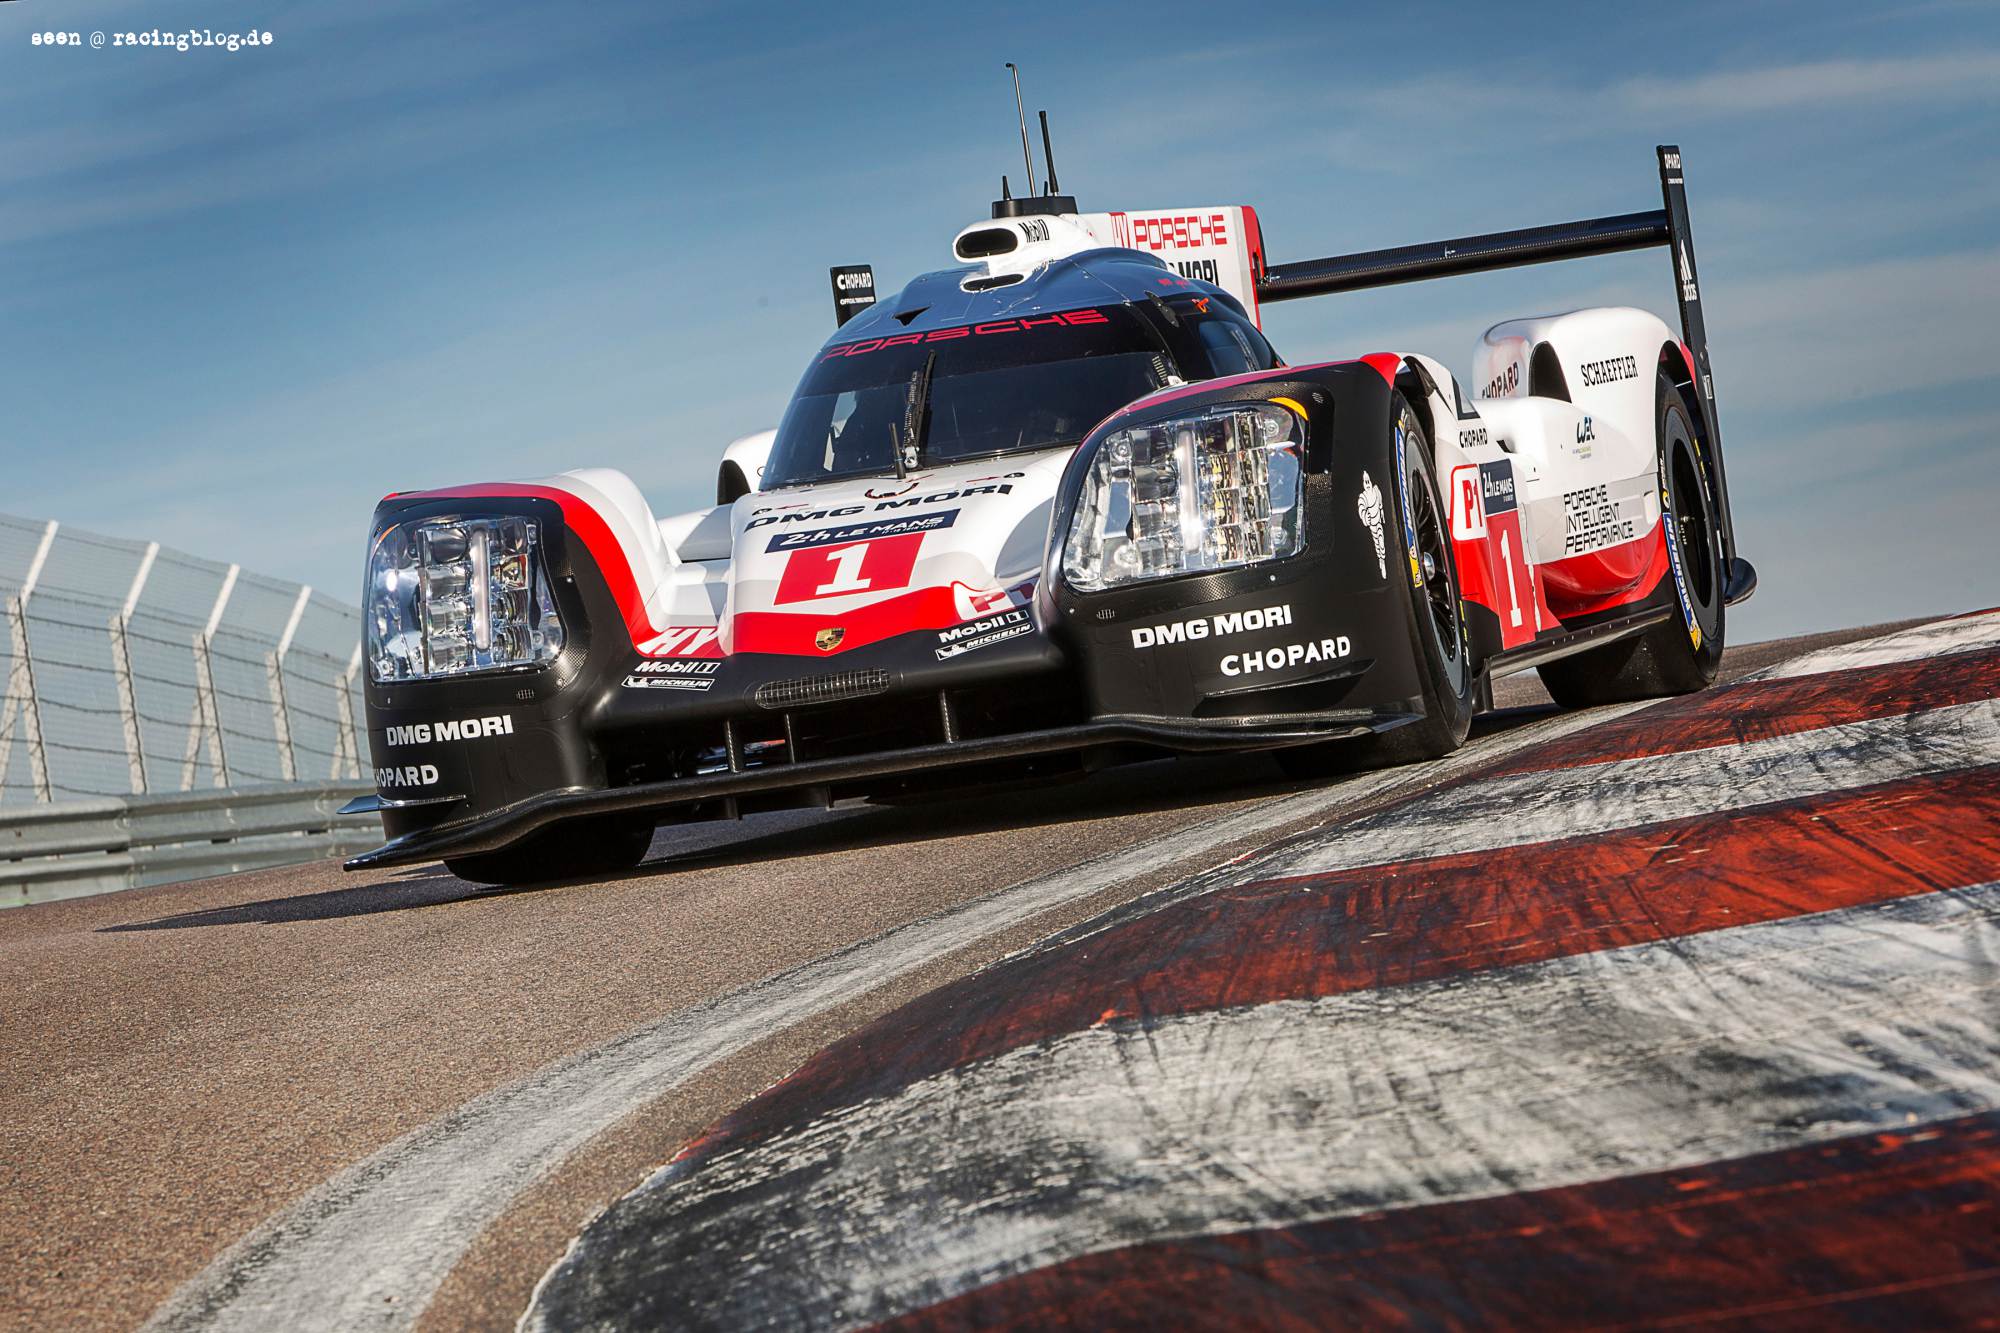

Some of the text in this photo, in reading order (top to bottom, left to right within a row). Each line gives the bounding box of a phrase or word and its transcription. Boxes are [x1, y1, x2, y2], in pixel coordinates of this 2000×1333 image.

[1133, 214, 1227, 250] PORSCHE
[837, 272, 872, 290] CHOPARD
[819, 310, 1109, 363] PORSCHE
[1580, 355, 1638, 387] SCHAEFFLER
[1459, 428, 1488, 449] CHOPARD
[1500, 477, 1513, 495] MANS
[1564, 484, 1608, 512] PORSCHE
[744, 484, 1014, 533] DMG MORI
[1462, 477, 1483, 529] P1
[1566, 503, 1619, 534] INTELLIGENT
[834, 528, 869, 539] LE
[869, 516, 945, 534] MANS
[1565, 521, 1634, 555] PERFORMANCE
[815, 543, 871, 596] 1
[1500, 529, 1523, 628] 1
[636, 628, 718, 655] HY
[938, 616, 1006, 643] Mobil
[966, 624, 1031, 648] MICHELIN
[1131, 604, 1293, 648] DMG MORI
[634, 661, 700, 673] Mobil
[1220, 635, 1352, 677] CHOPARD
[649, 679, 711, 688] MICHELIN
[386, 714, 514, 746] DMG MORI
